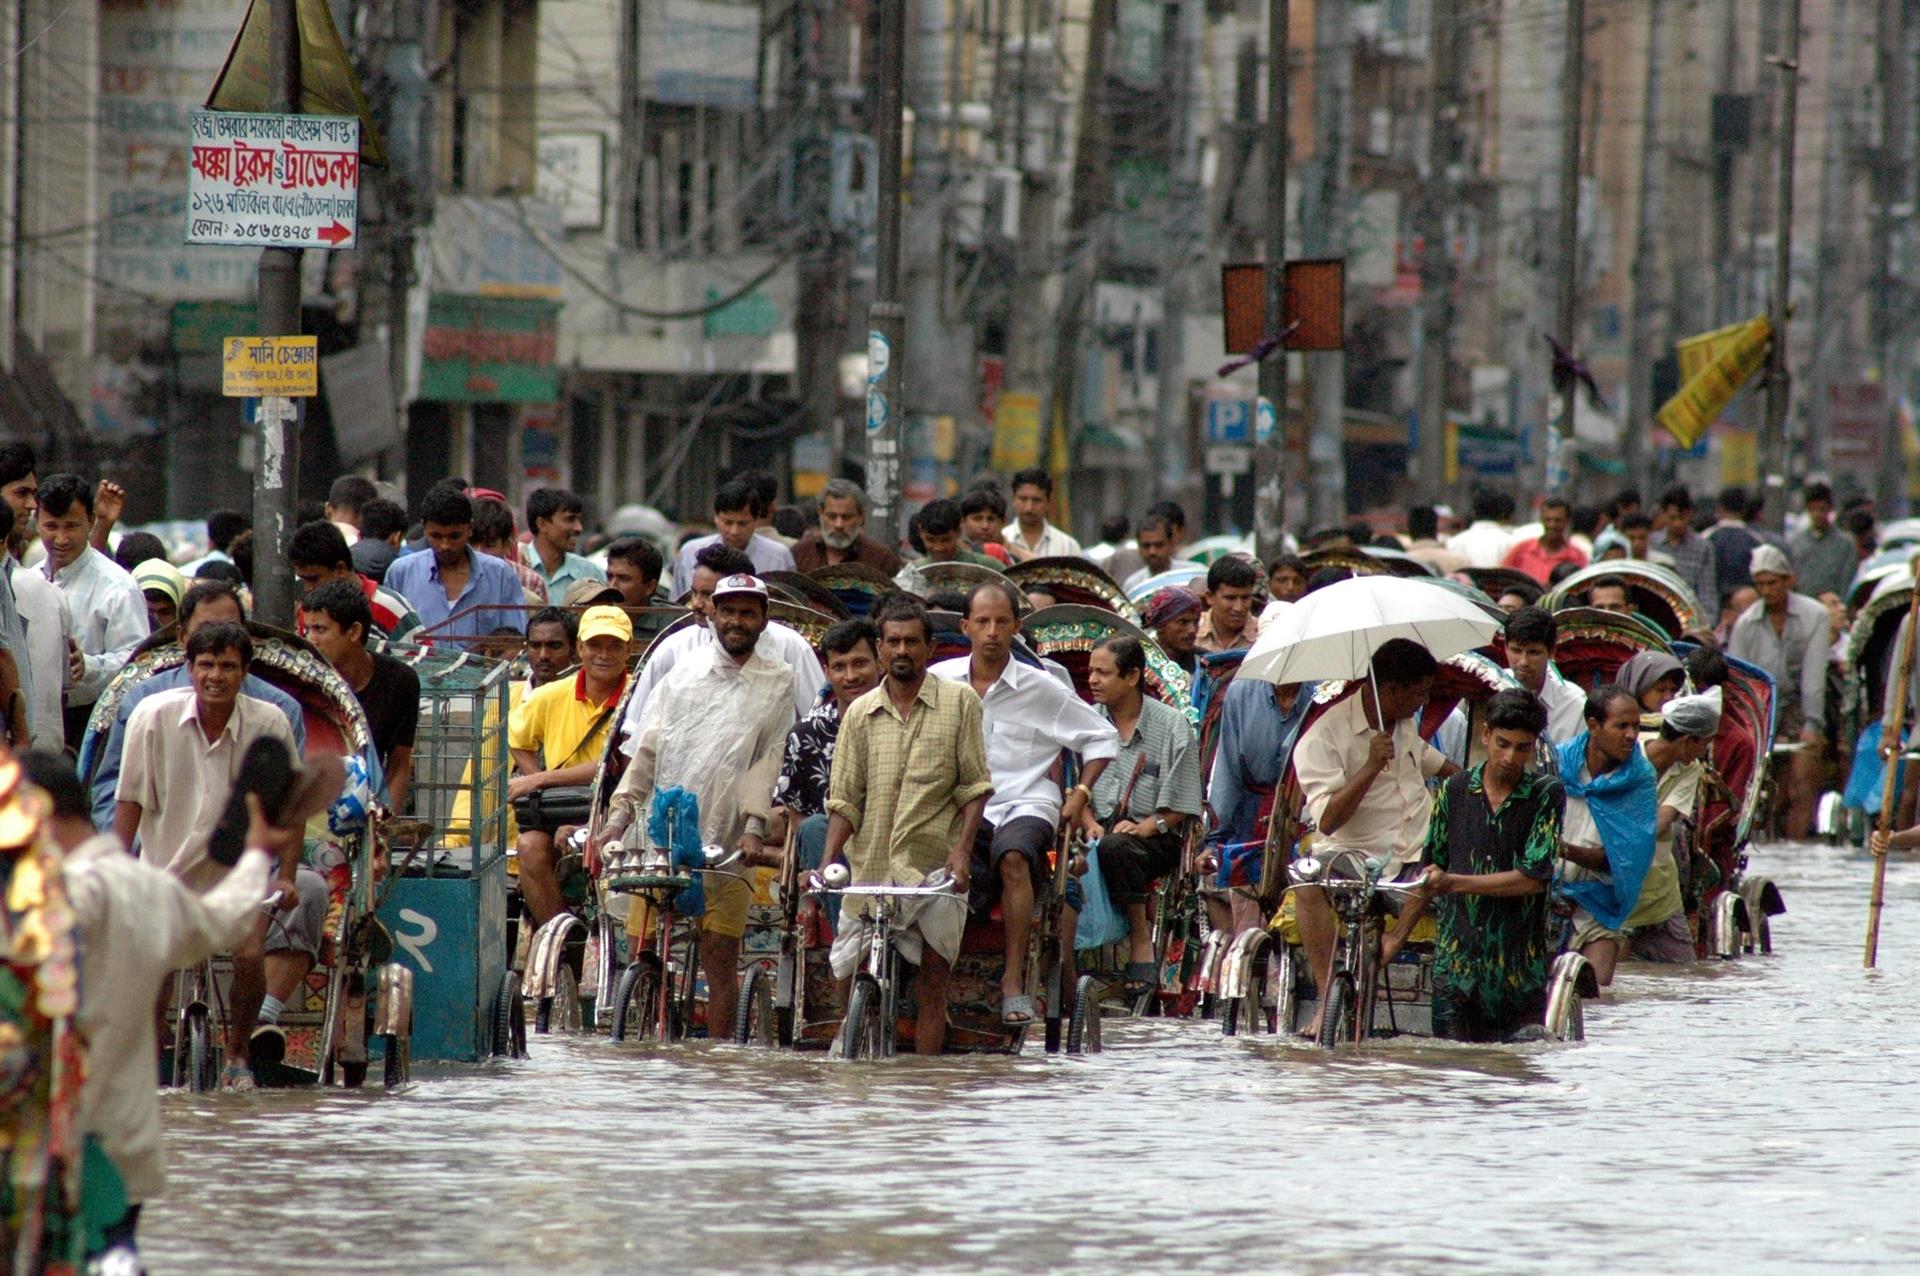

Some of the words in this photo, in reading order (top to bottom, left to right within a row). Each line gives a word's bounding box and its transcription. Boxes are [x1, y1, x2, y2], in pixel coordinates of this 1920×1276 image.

[192, 145, 231, 182] মক্কা
[226, 188, 270, 215] মতিঝিল
[233, 222, 311, 239] ৯৫৬৫৪৭৫
[248, 340, 275, 365] মানি
[1215, 400, 1242, 440] P
[395, 908, 437, 973] ২
